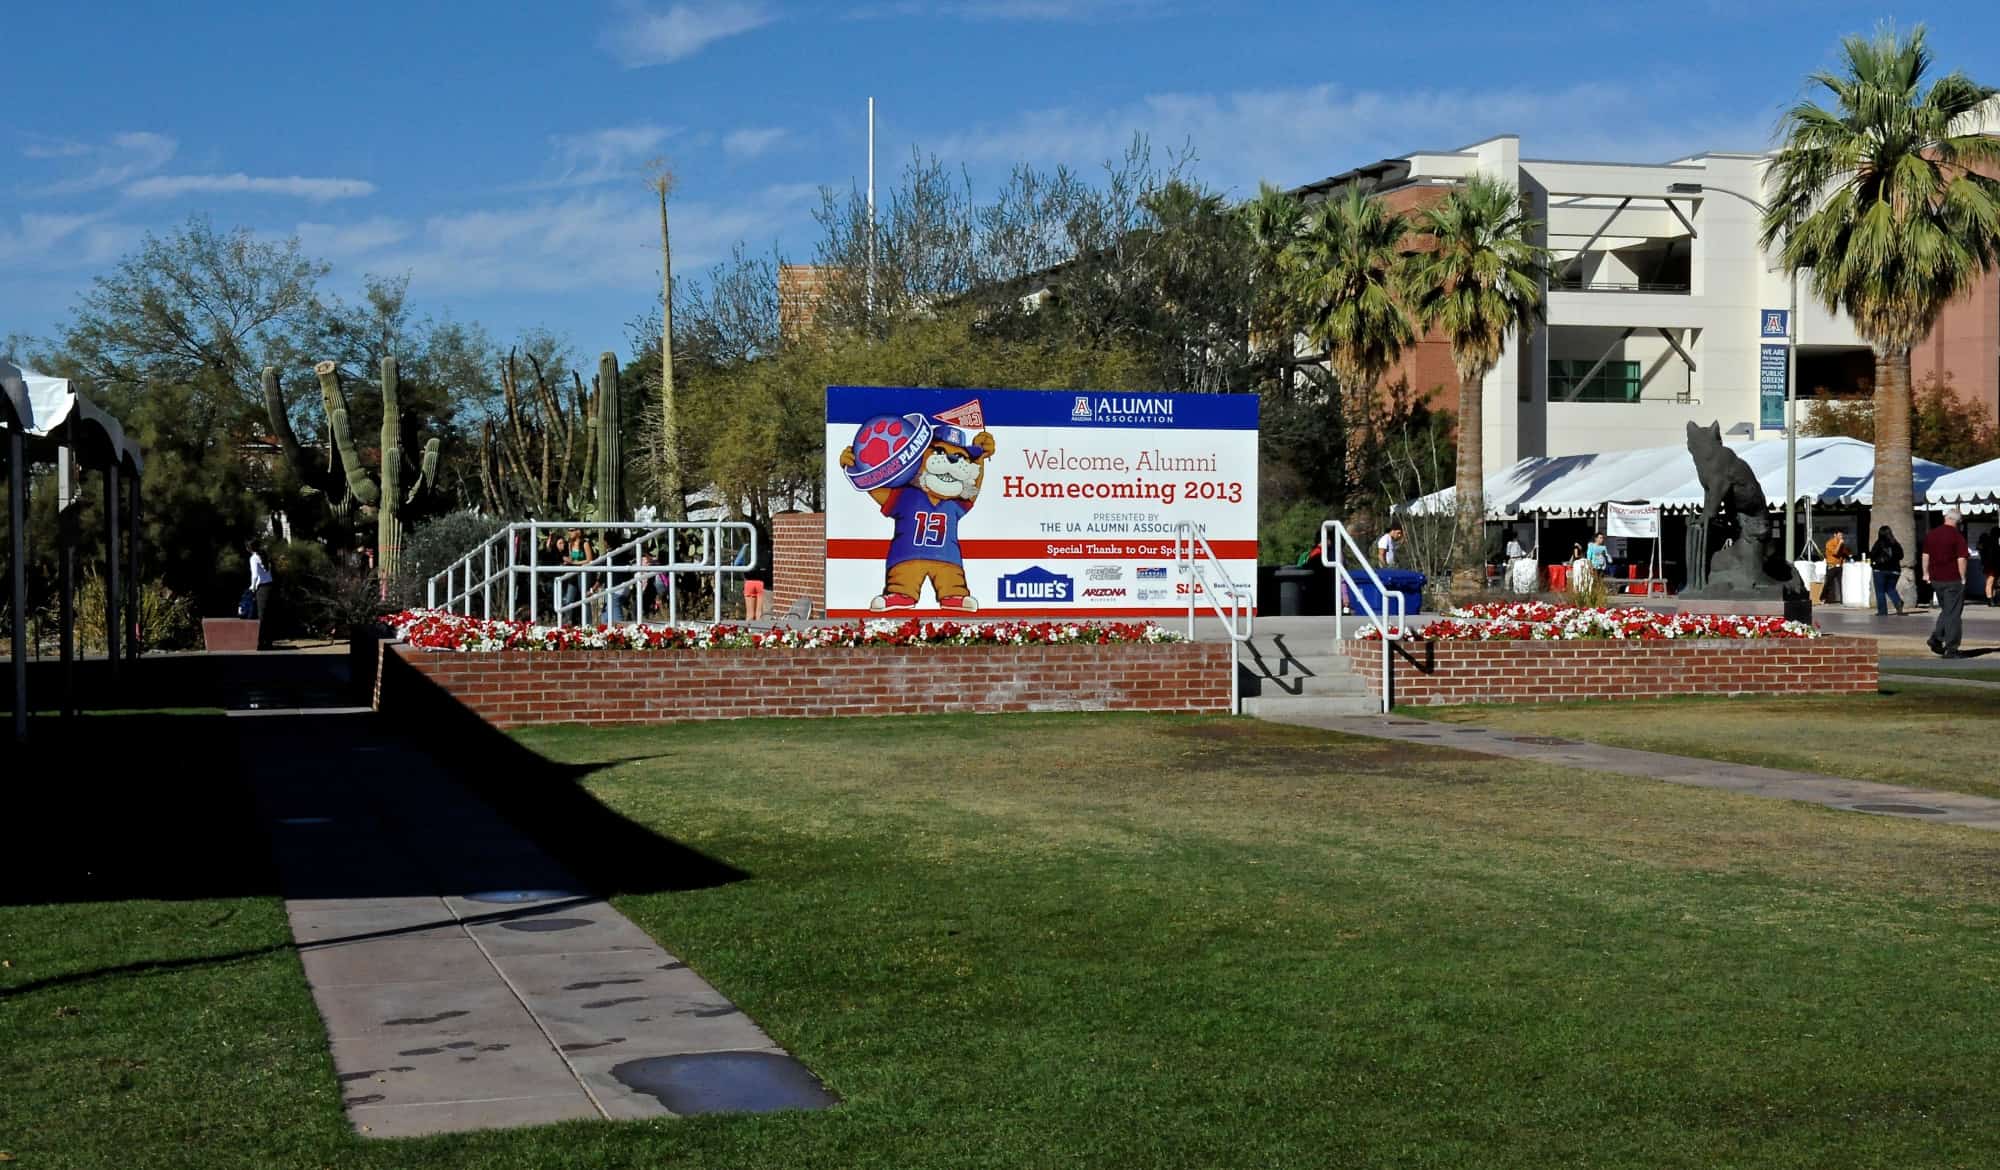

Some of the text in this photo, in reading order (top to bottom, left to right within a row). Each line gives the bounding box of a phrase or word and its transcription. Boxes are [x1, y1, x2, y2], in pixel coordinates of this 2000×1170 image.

[1098, 398, 1173, 414] ALUMNI
[1023, 448, 1217, 474] Welcome, Alumni
[1002, 476, 1243, 504] Homecoming 2013
[1093, 513, 1160, 521] PRESENTED BY
[913, 511, 947, 547] 13
[1040, 522, 1206, 533] THE UA ALUMNI ASSOCITIN
[1047, 544, 1083, 556] Special
[1086, 545, 1122, 555] Thanks
[1126, 545, 1136, 555] to
[1138, 546, 1158, 555] Our
[1005, 580, 1067, 599] LOWE'S
[1082, 588, 1126, 597] ARIZONA
